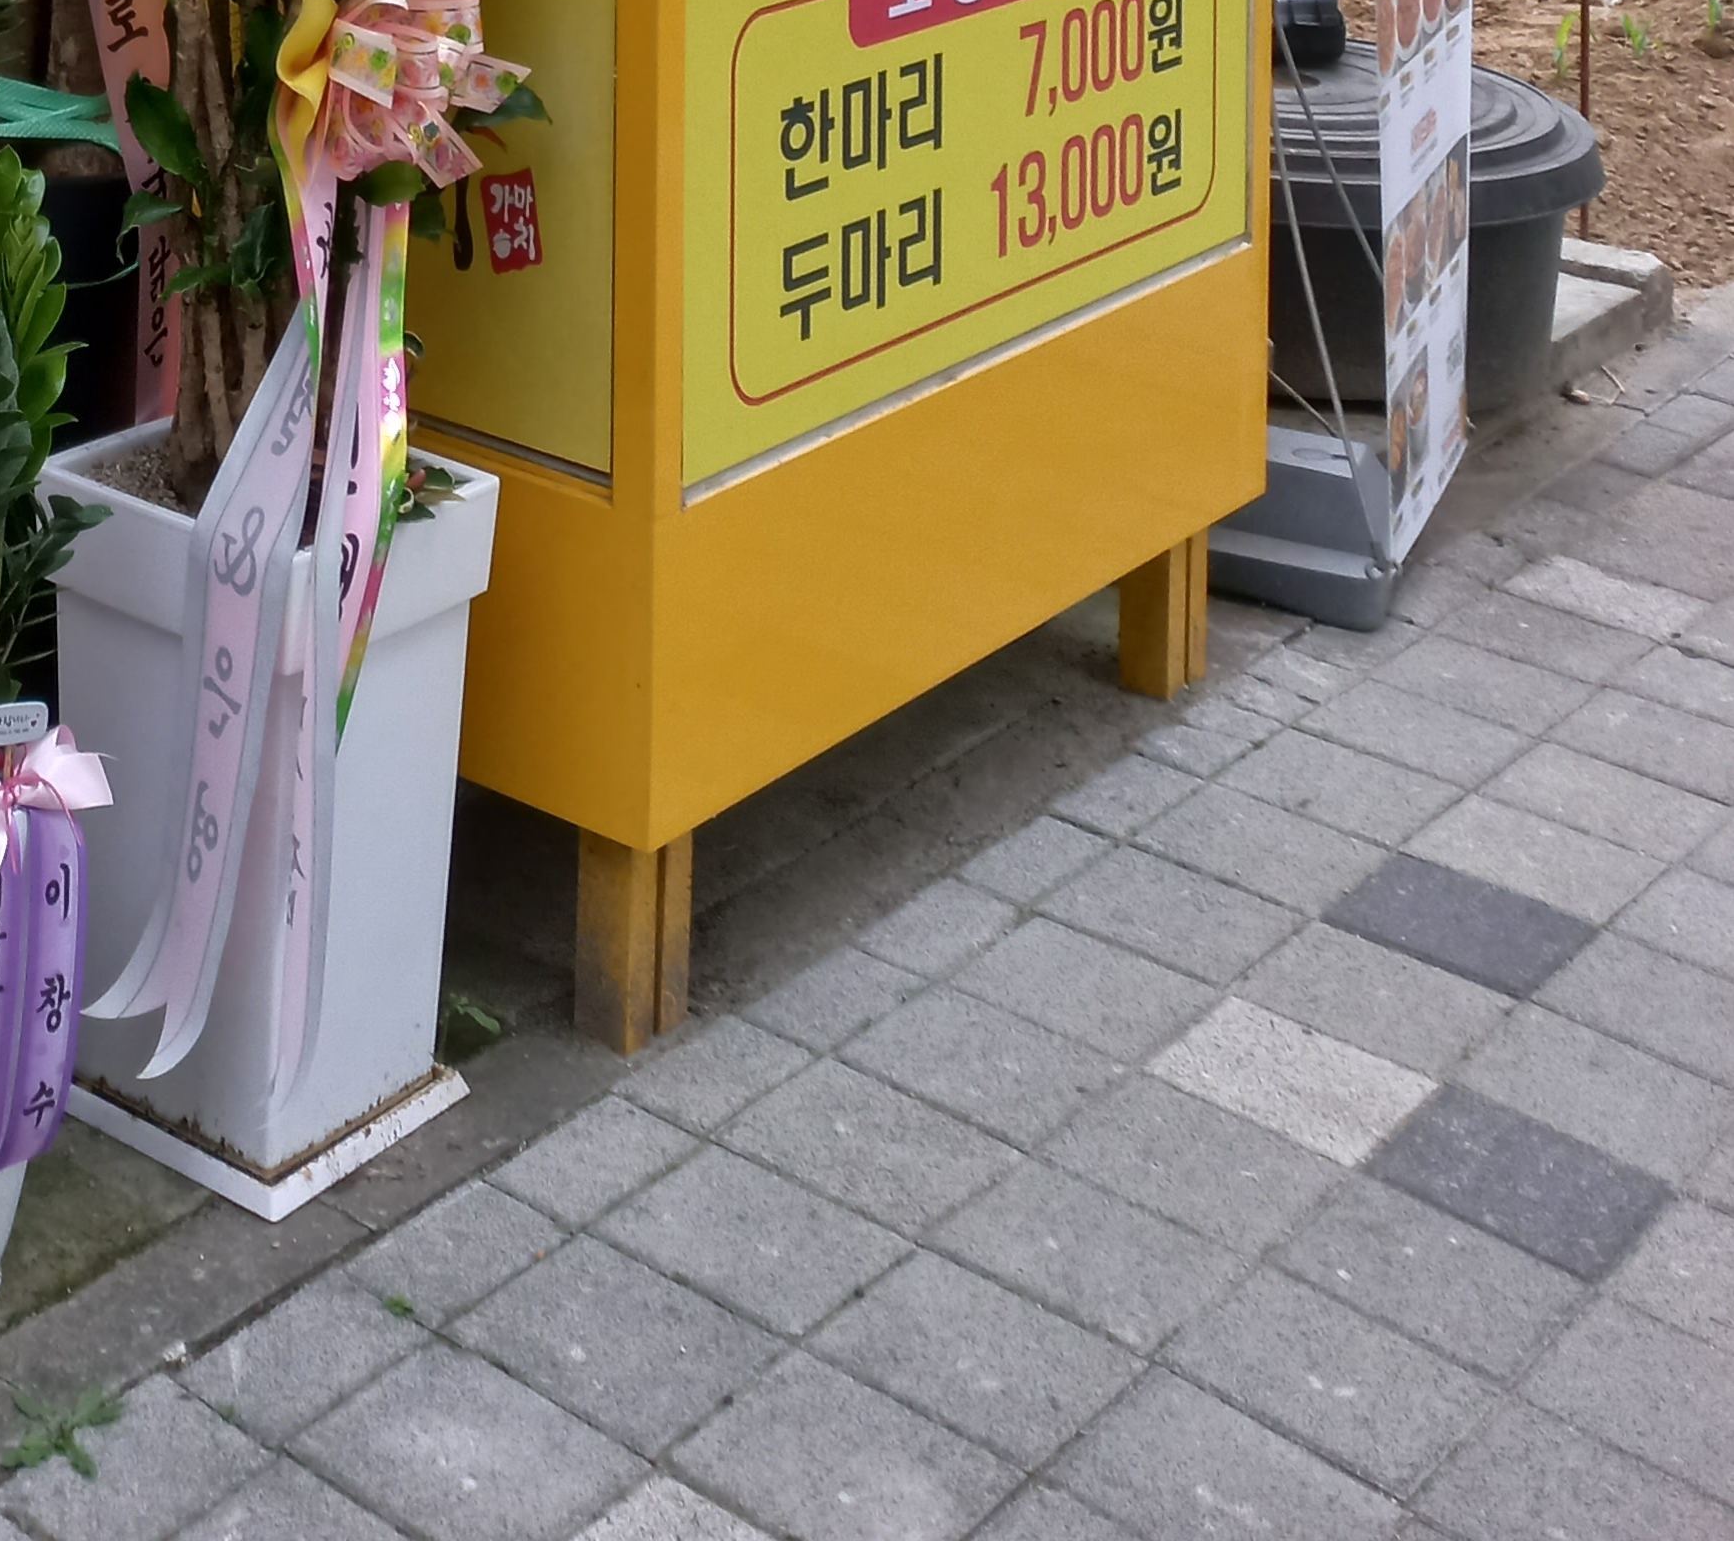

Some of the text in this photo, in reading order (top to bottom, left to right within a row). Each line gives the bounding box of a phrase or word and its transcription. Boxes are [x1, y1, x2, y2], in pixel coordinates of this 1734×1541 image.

[780, 52, 944, 202] 한마리
[779, 108, 1183, 342] 두마리 13,000원
